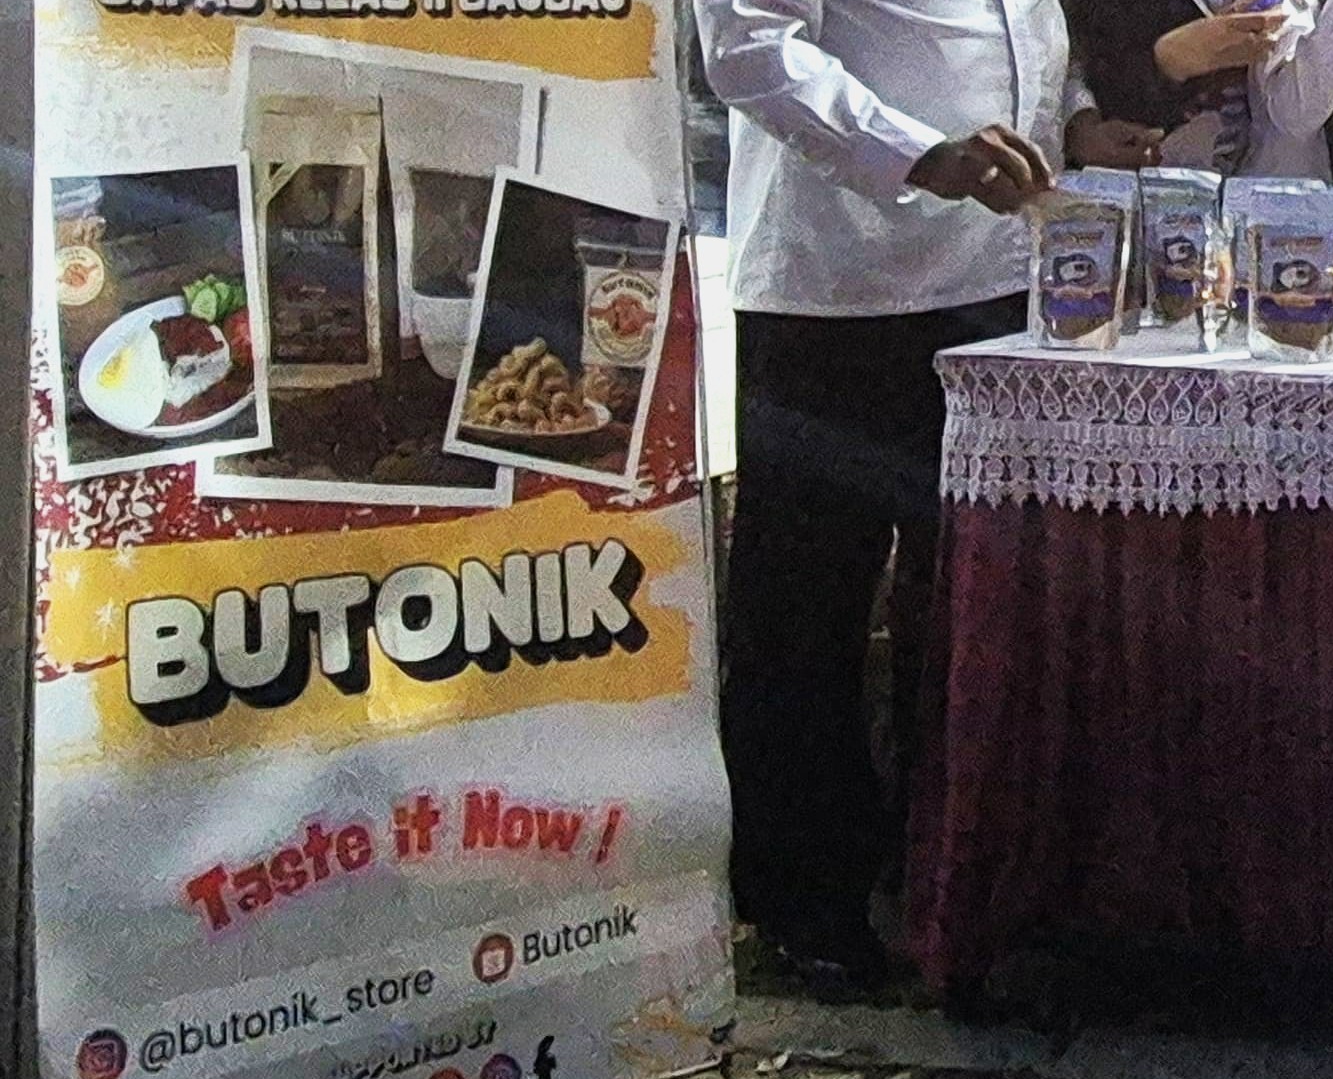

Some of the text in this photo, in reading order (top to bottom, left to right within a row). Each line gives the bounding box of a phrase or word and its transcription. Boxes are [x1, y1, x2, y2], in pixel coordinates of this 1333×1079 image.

[127, 538, 646, 725] BUTONIK
[186, 821, 373, 932] Taste
[392, 793, 440, 857] it
[462, 789, 583, 853] Now
[521, 904, 638, 967] Butonik
[139, 965, 435, 1073] @butonik_store
